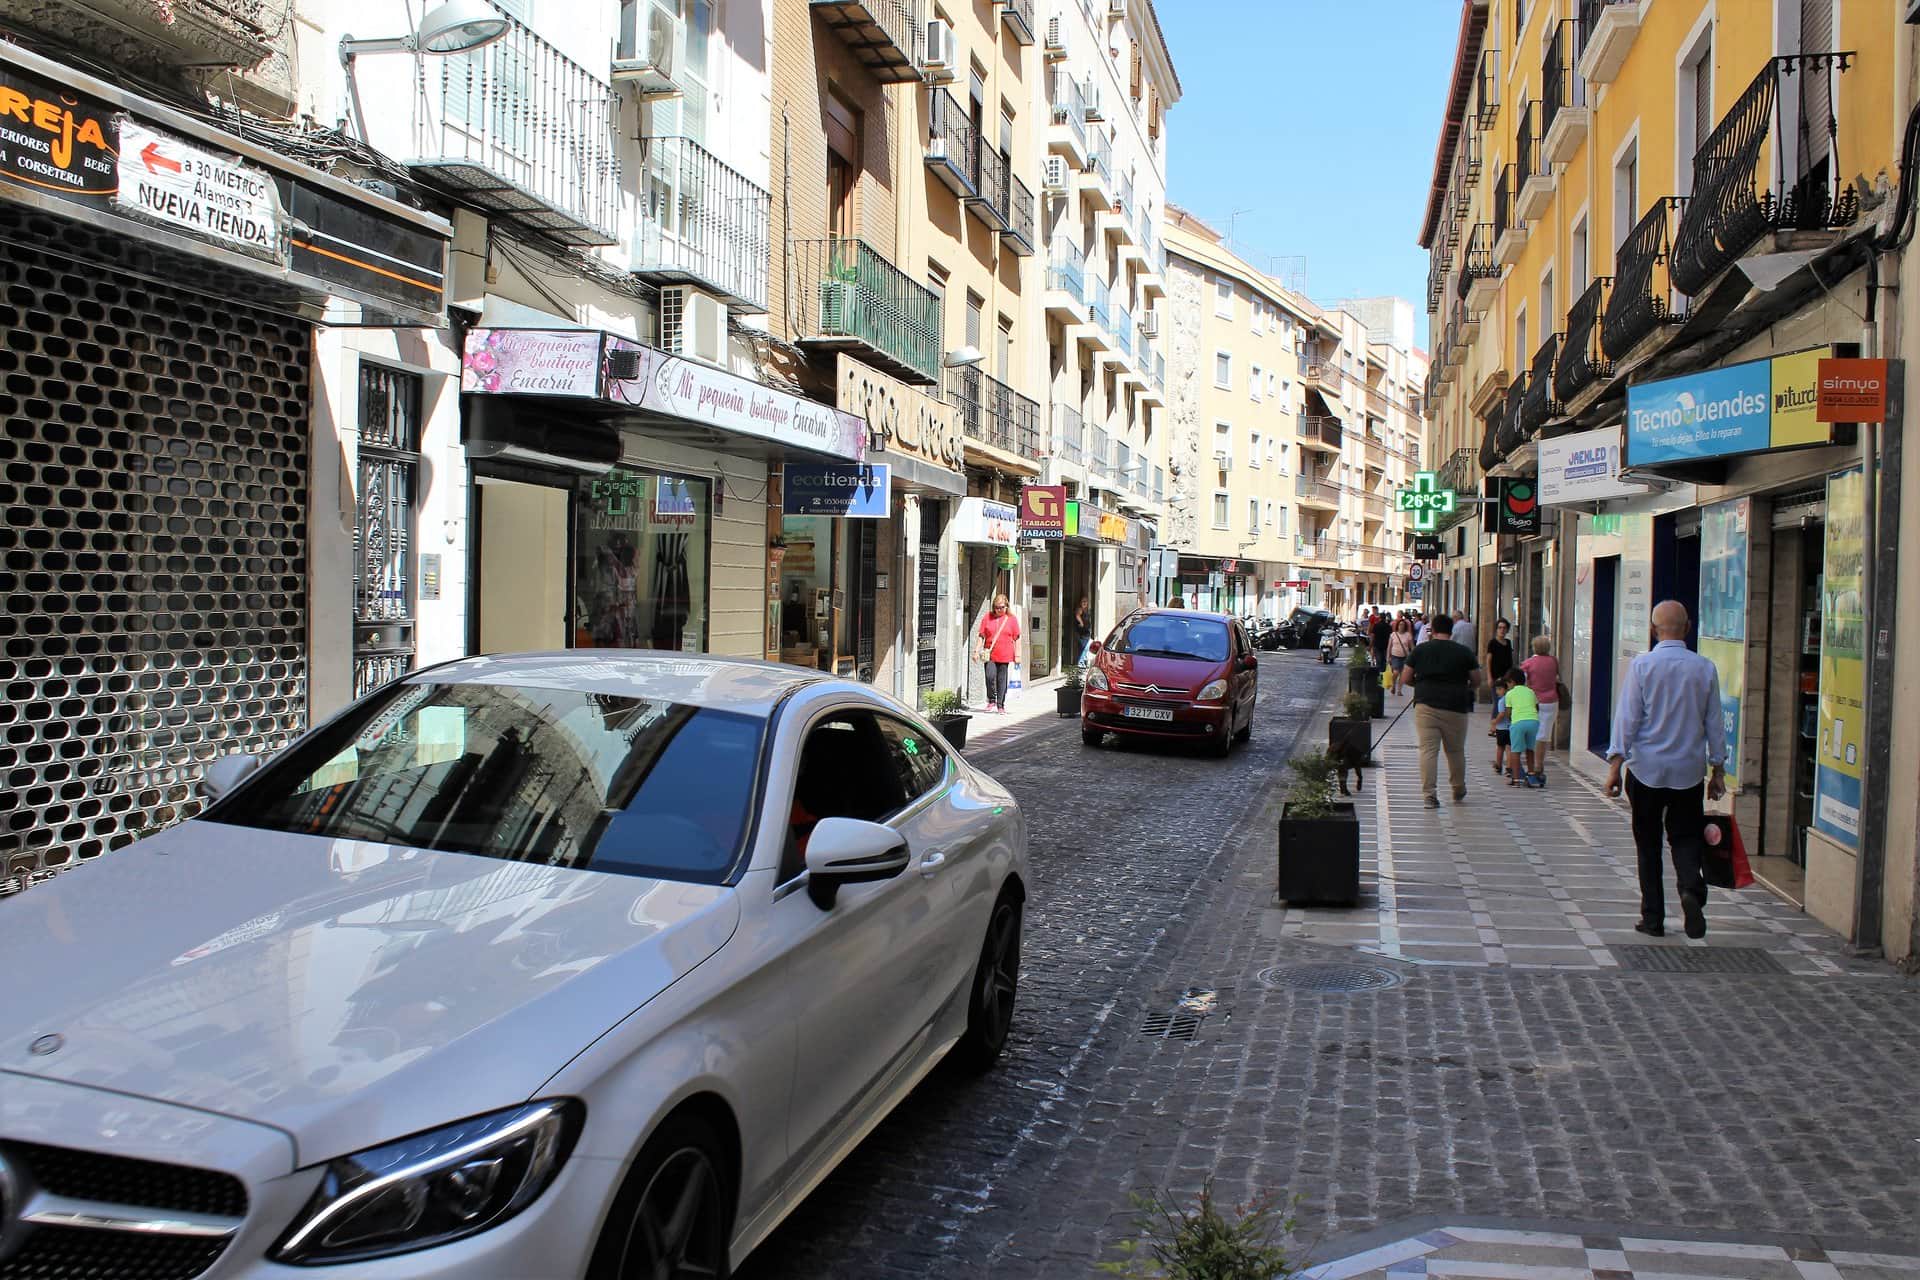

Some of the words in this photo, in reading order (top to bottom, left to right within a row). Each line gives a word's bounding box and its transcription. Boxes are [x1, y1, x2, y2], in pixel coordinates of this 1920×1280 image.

[17, 156, 84, 187] CORSETERIA
[84, 157, 111, 175] BEBE
[184, 160, 192, 172] a
[196, 160, 212, 179] 30
[213, 167, 265, 201] METROS
[138, 183, 200, 224] NUEVA
[206, 206, 268, 246] TIENDA
[520, 337, 582, 356] pequeña
[529, 353, 593, 375] boutique
[510, 368, 576, 391] Encarni
[1823, 375, 1879, 394] simyo
[673, 367, 695, 400] Mi
[697, 384, 745, 418] pequeña
[749, 391, 789, 432] boutique
[792, 400, 829, 440] Encarni
[792, 467, 882, 492] ecotienda
[1023, 529, 1063, 538] TABACOS
[1130, 707, 1152, 717] 3217
[1154, 710, 1172, 720] GXV
